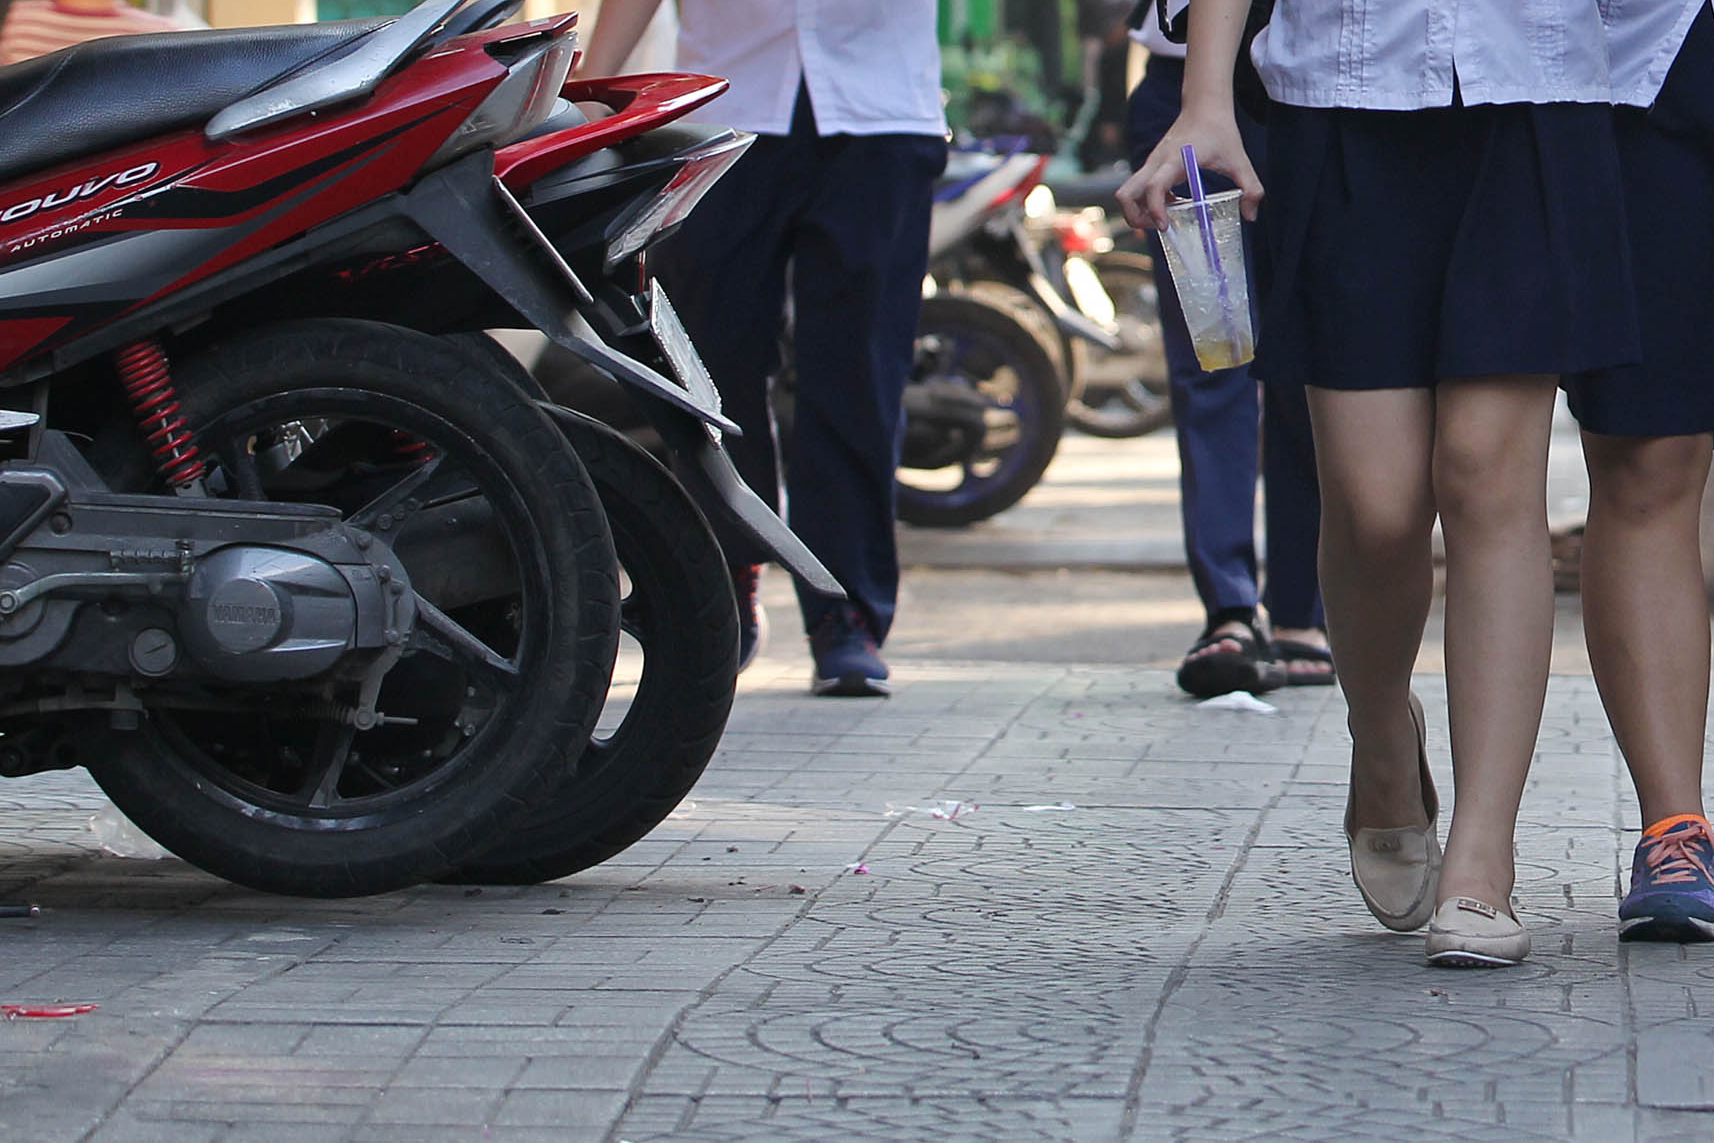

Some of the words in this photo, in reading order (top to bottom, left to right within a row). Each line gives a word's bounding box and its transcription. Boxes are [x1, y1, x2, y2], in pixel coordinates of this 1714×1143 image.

[0, 161, 160, 224] OUVO
[10, 208, 124, 253] AUTOMATIC
[213, 604, 278, 626] YAMAHA
